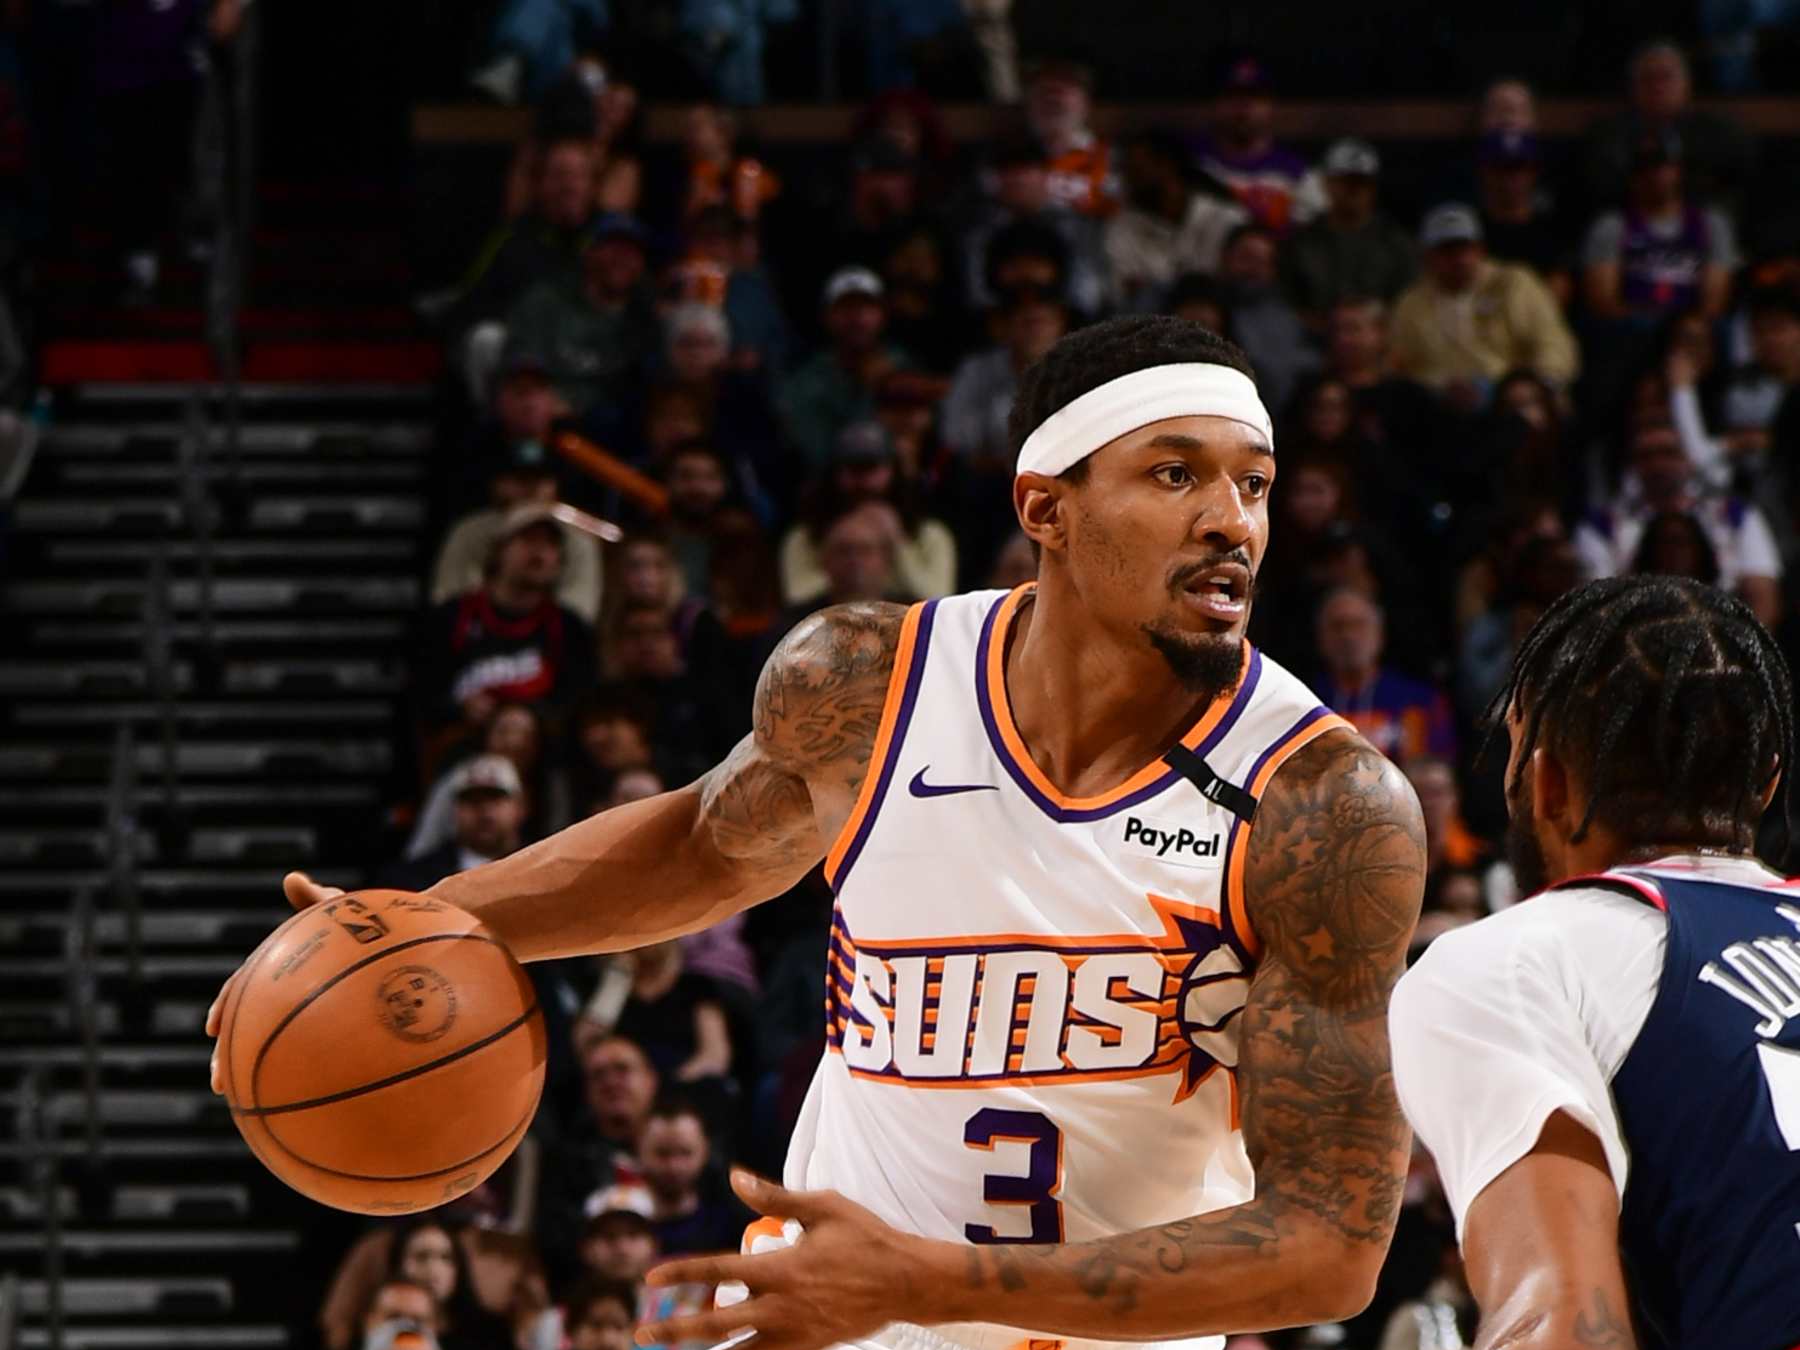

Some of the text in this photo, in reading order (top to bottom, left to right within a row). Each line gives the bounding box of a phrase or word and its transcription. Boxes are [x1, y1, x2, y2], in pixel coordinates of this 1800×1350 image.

[1203, 777, 1224, 801] AL
[1123, 815, 1221, 857] PayPal
[842, 949, 1165, 1077] SUNS
[963, 1106, 1066, 1244] 3
